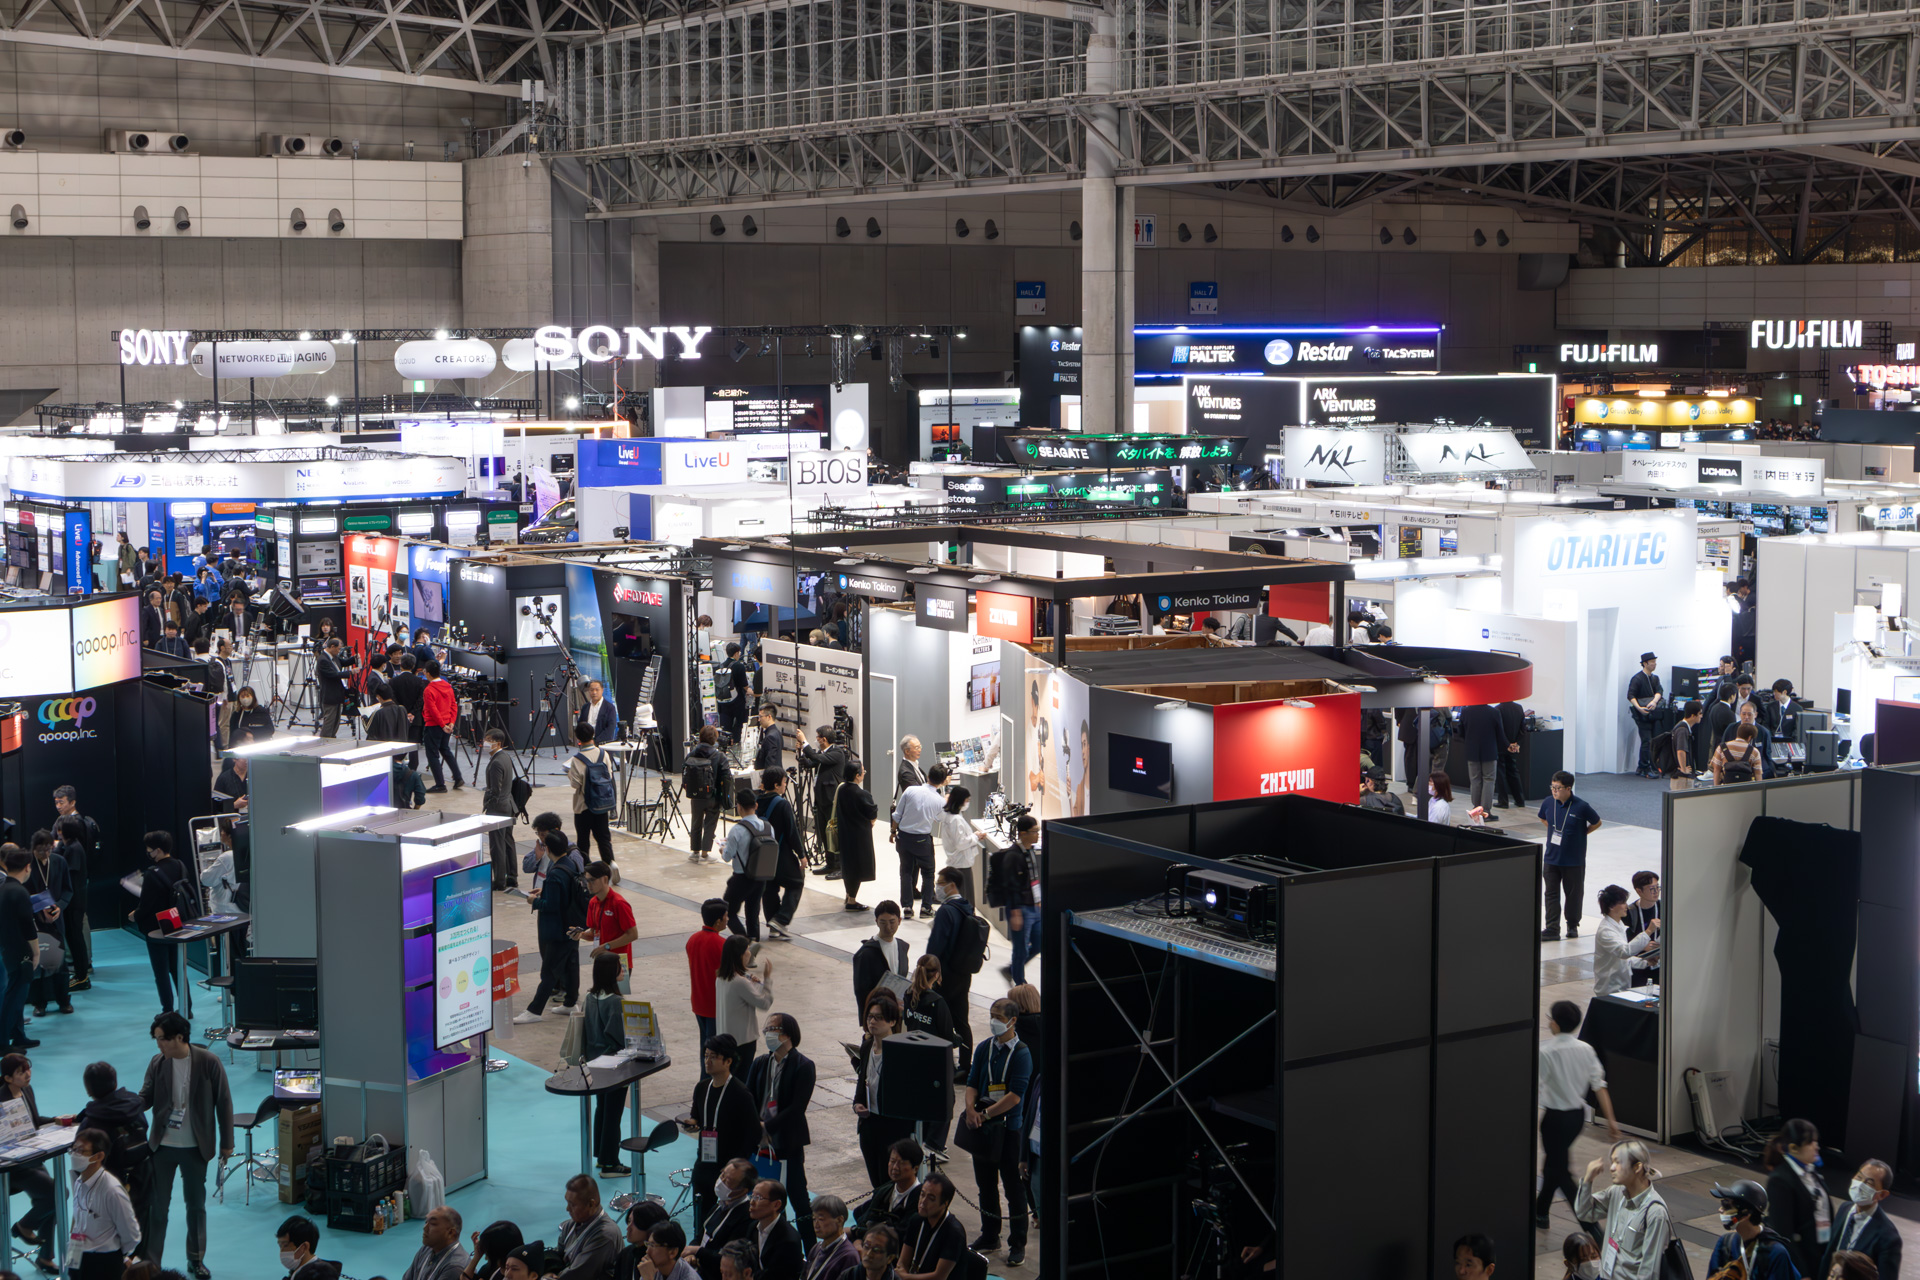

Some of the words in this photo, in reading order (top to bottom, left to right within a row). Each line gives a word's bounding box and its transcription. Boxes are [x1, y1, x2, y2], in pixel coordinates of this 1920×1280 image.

[1035, 285, 1041, 296] 7
[1208, 285, 1214, 295] 7
[1751, 319, 1863, 349] FUJIFILM
[120, 328, 190, 366] SONY
[535, 325, 712, 362] SONY
[219, 354, 276, 363] NETWORKED
[1190, 351, 1235, 363] PALTEK
[1297, 342, 1353, 361] Restar
[1561, 344, 1658, 363] FUJIFILM
[1060, 375, 1077, 383] PALTEK
[1192, 385, 1211, 397] ARK
[1313, 388, 1337, 400] ARK
[1197, 397, 1242, 410] VENTURES
[1320, 399, 1376, 412] VENTURES
[618, 446, 640, 460] LiveU
[1039, 446, 1089, 460] SEAGATE
[1117, 443, 1233, 461] ペタバイトを、解放しよう。
[684, 452, 730, 469] LiveU
[1303, 439, 1367, 481] NKL
[797, 458, 861, 485] BIOS
[1702, 467, 1738, 477] UCHIDA
[1765, 470, 1815, 483] 内田洋行
[947, 481, 985, 492] Seagate
[948, 495, 976, 503] stores
[74, 523, 82, 546] LiveU
[1547, 532, 1667, 571] OTARITEC
[849, 578, 871, 589] Kenko
[872, 581, 897, 593] Tokina
[1174, 597, 1210, 607] Kenko
[1212, 594, 1250, 604] Tokina
[76, 628, 138, 661] qooop,Inc.
[777, 657, 805, 667] マイクブームール
[38, 729, 98, 744] qooop,Inc.
[1260, 768, 1315, 795] ZHIYUN
